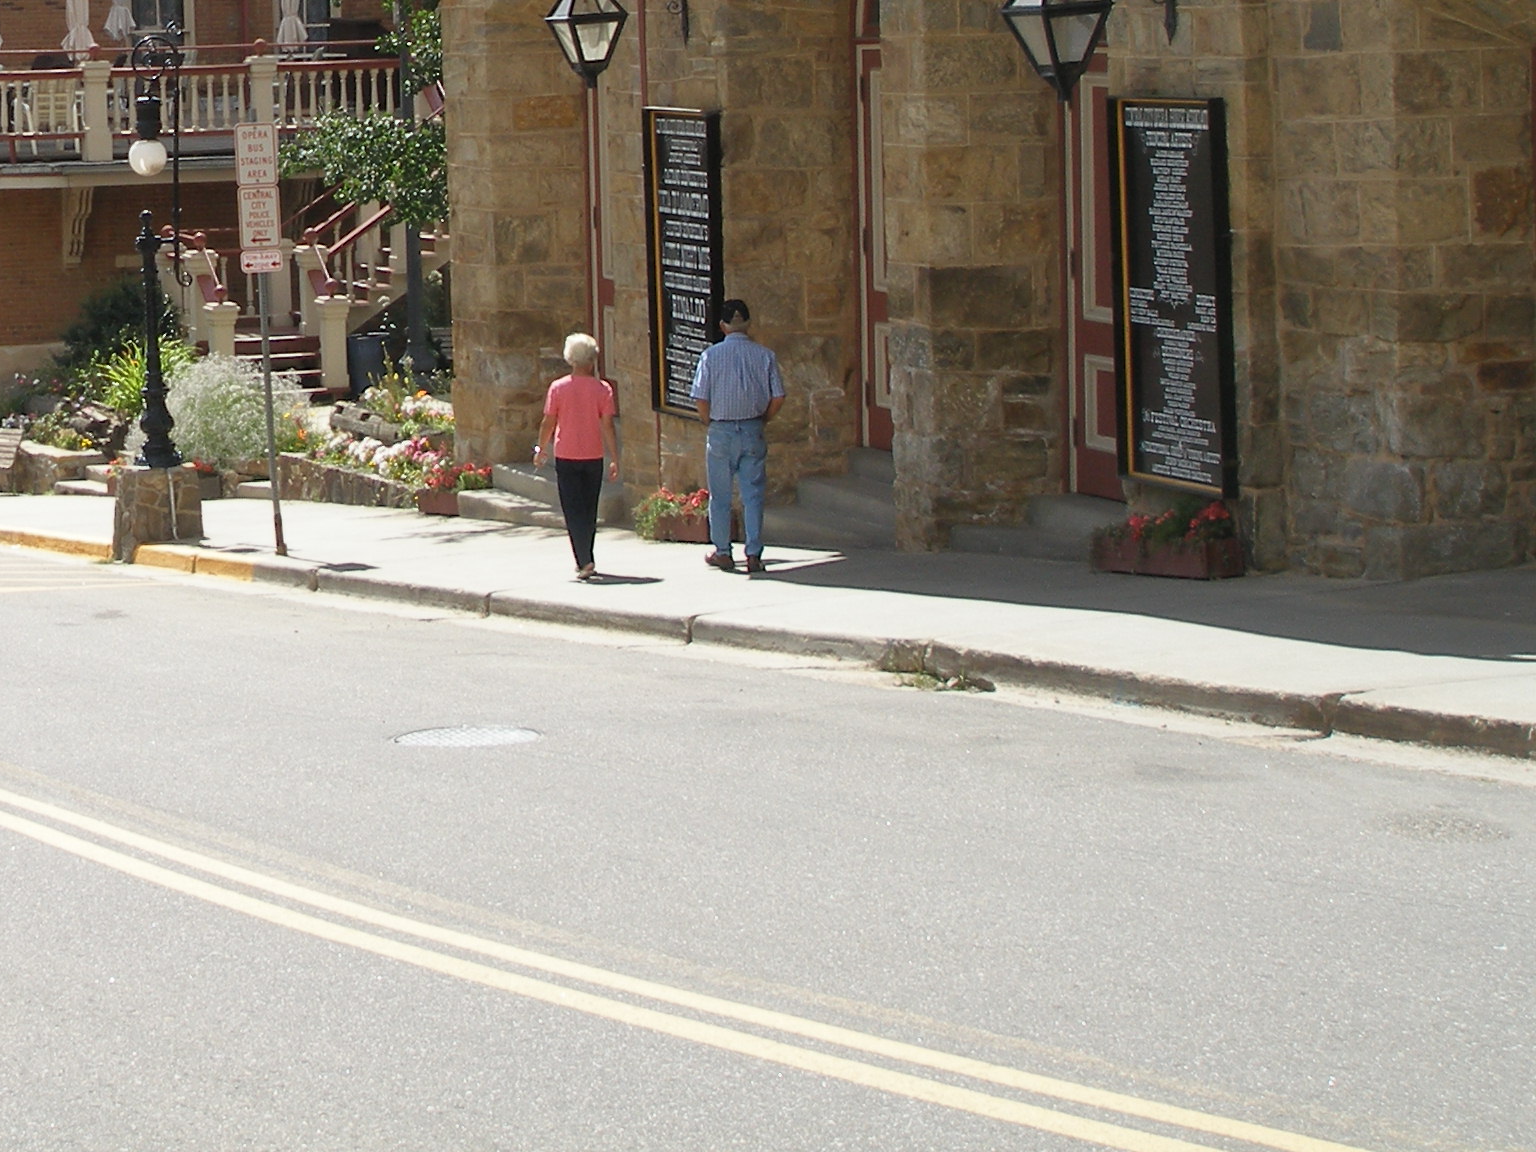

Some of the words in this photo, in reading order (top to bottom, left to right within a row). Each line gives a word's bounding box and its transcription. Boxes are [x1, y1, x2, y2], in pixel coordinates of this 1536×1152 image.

[242, 131, 269, 140] OPERA
[247, 143, 264, 153] BUS
[240, 156, 273, 166] STAGING
[247, 169, 267, 179] AREA
[243, 191, 273, 200] CENTRAL
[251, 201, 267, 209] CITY
[249, 211, 270, 219] POLICE
[245, 220, 275, 229] VEHICLES
[252, 229, 269, 237] ONLY
